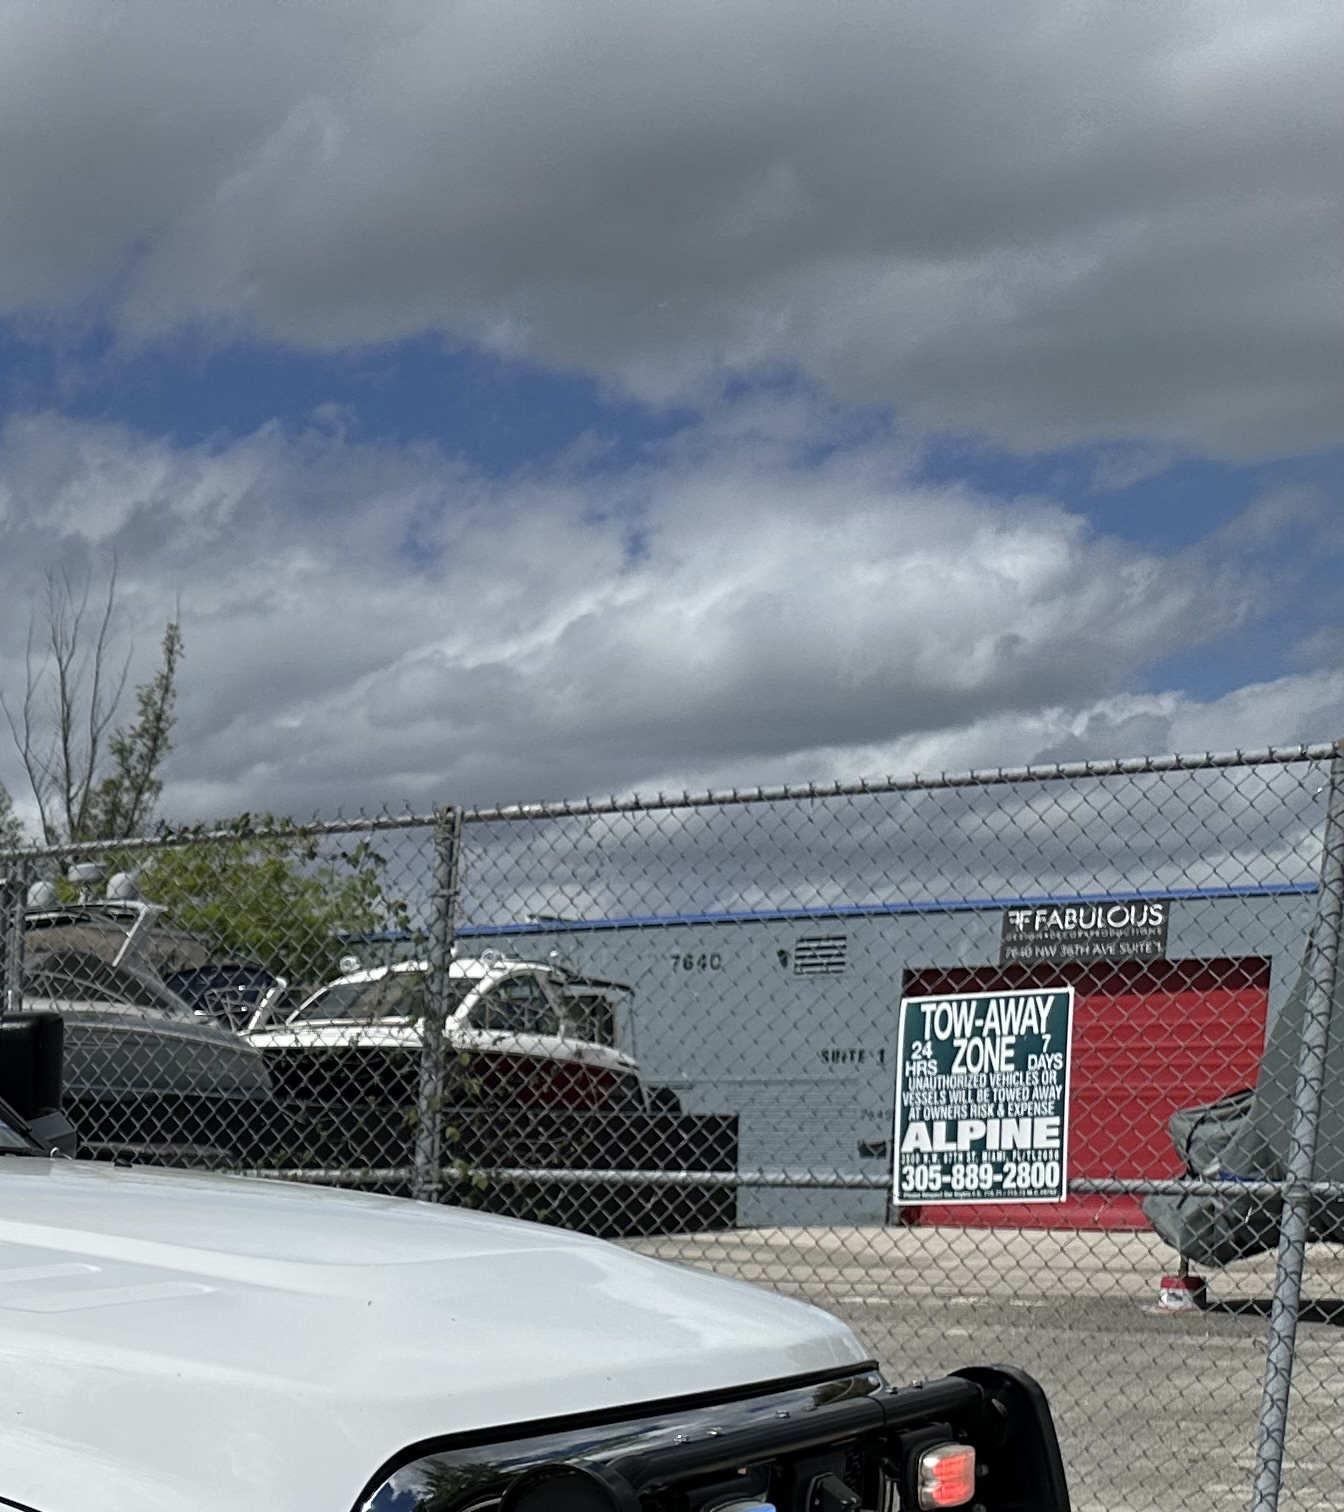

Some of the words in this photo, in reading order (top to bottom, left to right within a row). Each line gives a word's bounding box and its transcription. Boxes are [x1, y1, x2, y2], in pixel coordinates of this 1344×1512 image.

[1034, 903, 1163, 932] FABULOUS
[1034, 944, 1057, 957] NW
[1092, 942, 1116, 956] AVE
[1120, 940, 1152, 955] SUITE
[670, 953, 722, 971] 7640
[920, 995, 1055, 1041] TOW-AWAY
[911, 1041, 934, 1060] 24
[1041, 1034, 1052, 1053] 7
[951, 1035, 1016, 1075] ZONE
[1027, 1052, 1063, 1071] DAYS
[905, 1059, 938, 1077] HRS
[908, 1073, 987, 1091] UNAUTHORIZED
[990, 1071, 1039, 1089] VEHICLES
[1041, 1069, 1057, 1085] OR
[902, 1090, 946, 1107] VESSELS
[949, 1088, 974, 1106] WILL
[977, 1088, 990, 1104] BE
[992, 1086, 1029, 1103] TOWED
[1031, 1084, 1062, 1101] AWAY
[908, 1105, 921, 1121] AT
[923, 1103, 967, 1121] OWNERS
[970, 1102, 994, 1119] RISK
[996, 1102, 1005, 1117] &
[1007, 1100, 1055, 1117] EXPENSE
[901, 1116, 1061, 1153] ALPINE
[901, 1162, 1060, 1191] 305-889-2800
